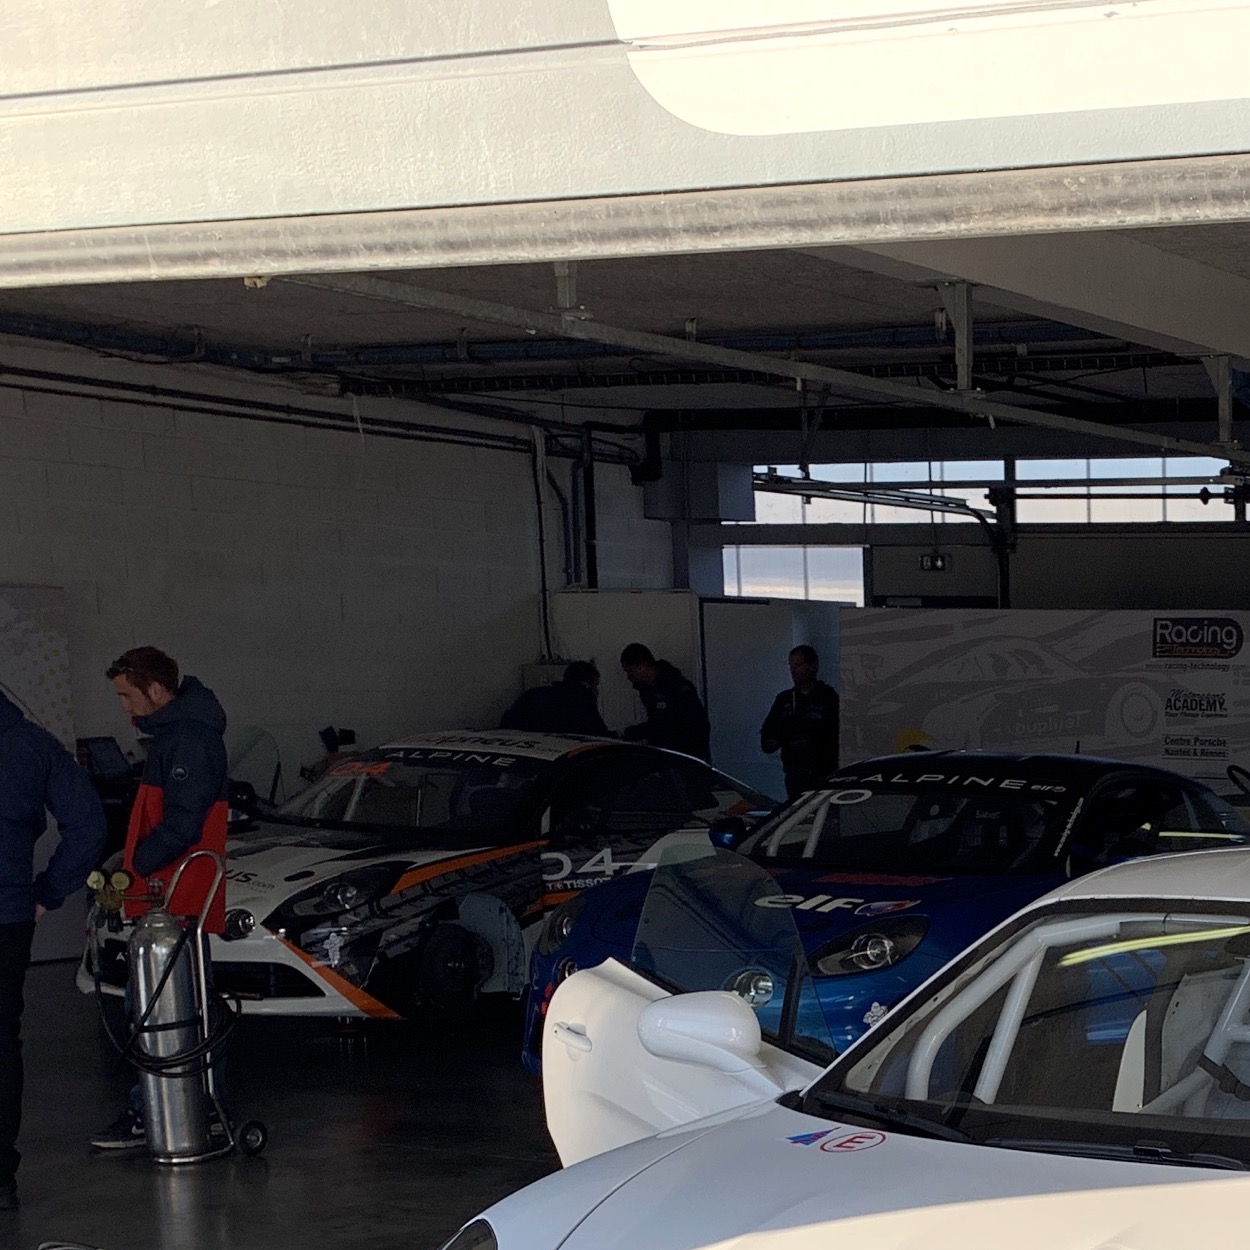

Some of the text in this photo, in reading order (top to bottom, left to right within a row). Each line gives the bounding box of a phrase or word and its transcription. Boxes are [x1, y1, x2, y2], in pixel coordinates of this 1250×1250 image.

[1156, 620, 1237, 649] Racing
[1165, 698, 1225, 711] ACADEMY
[1164, 736, 1227, 747] Centre Porsche
[385, 751, 517, 767] ALPINE
[1164, 748, 1191, 757] Nantes
[860, 773, 1028, 790] ALPINE
[754, 894, 864, 913] elf
